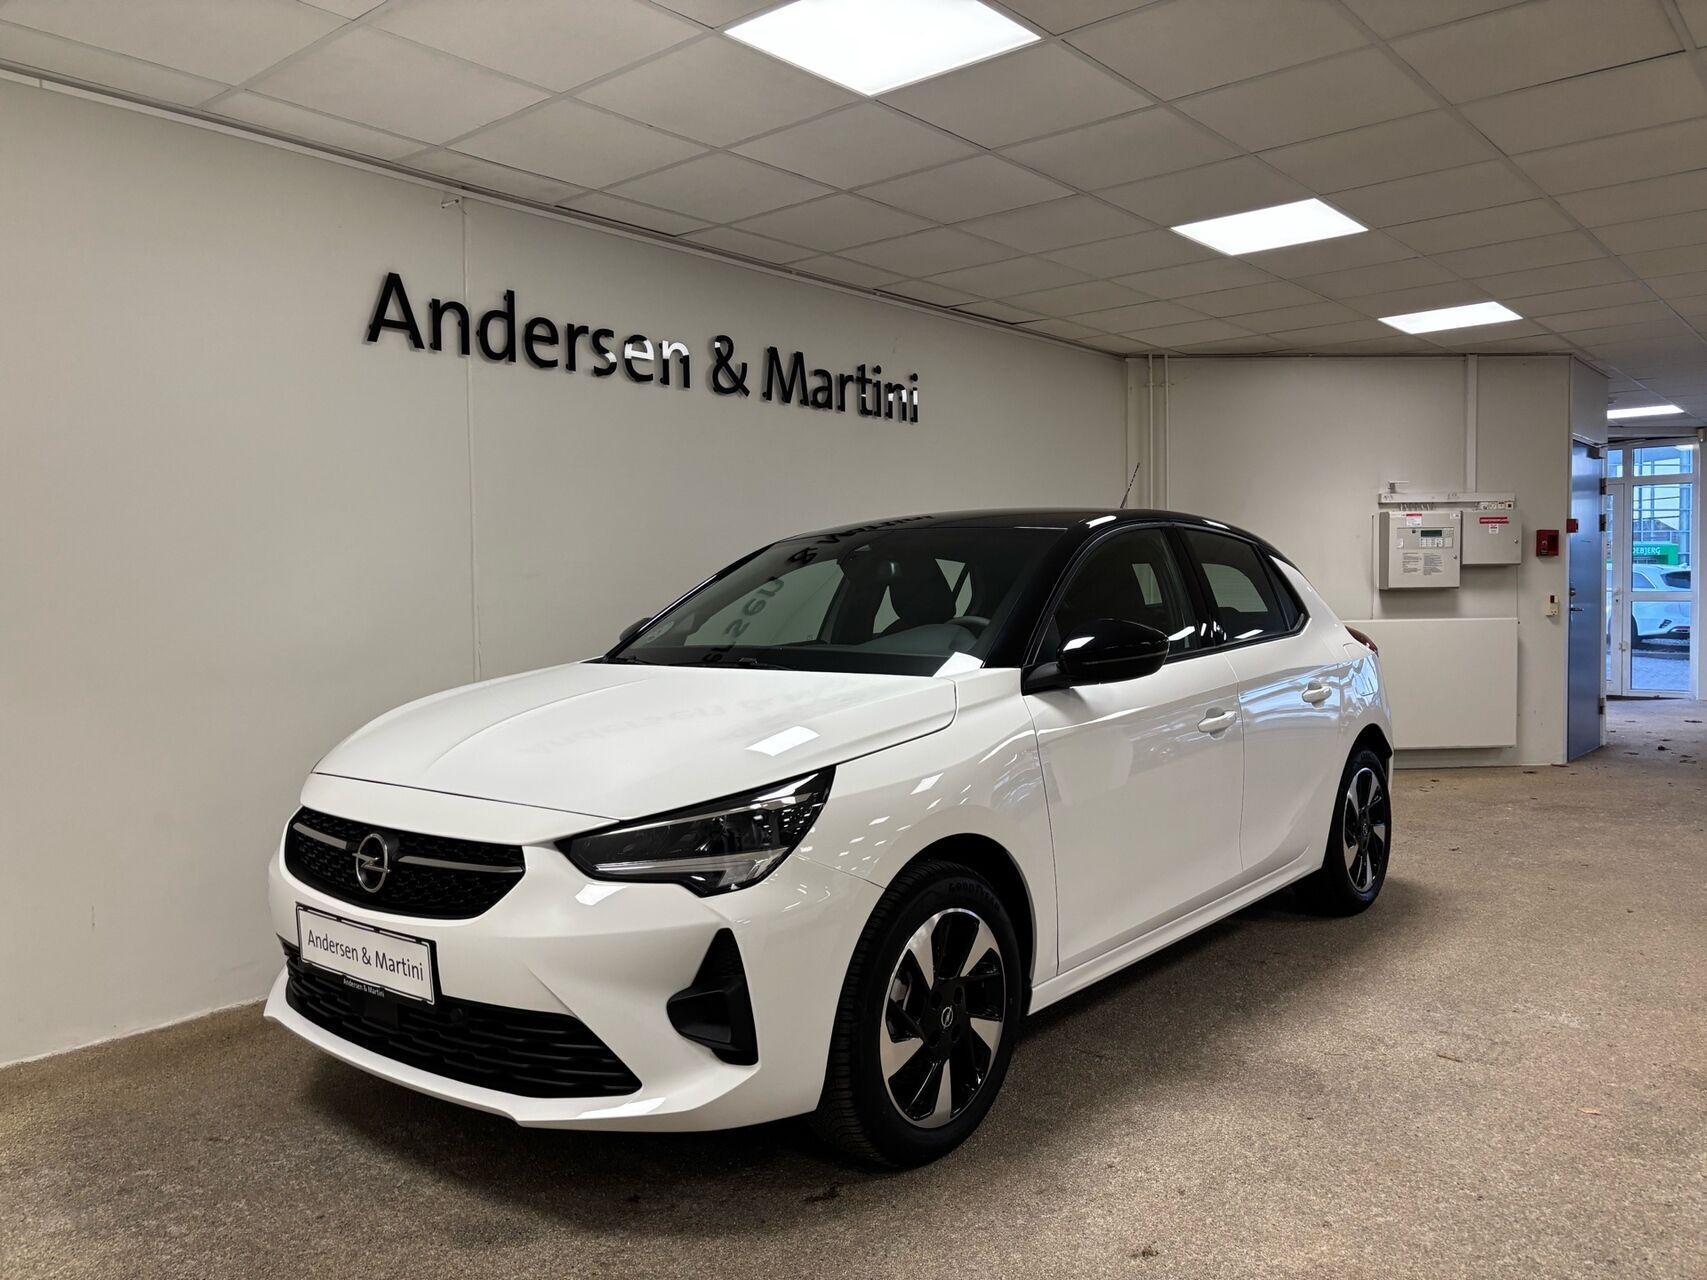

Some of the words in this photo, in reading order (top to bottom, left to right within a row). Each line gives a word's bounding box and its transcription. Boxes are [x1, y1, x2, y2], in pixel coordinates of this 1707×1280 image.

[366, 271, 691, 388] Andersen
[712, 335, 751, 398] &
[762, 345, 919, 423] Martini
[307, 929, 359, 962] Andersen
[361, 946, 372, 966] &
[375, 950, 424, 981] Martini
[343, 978, 364, 991] Andersen
[367, 985, 385, 998] Martini
